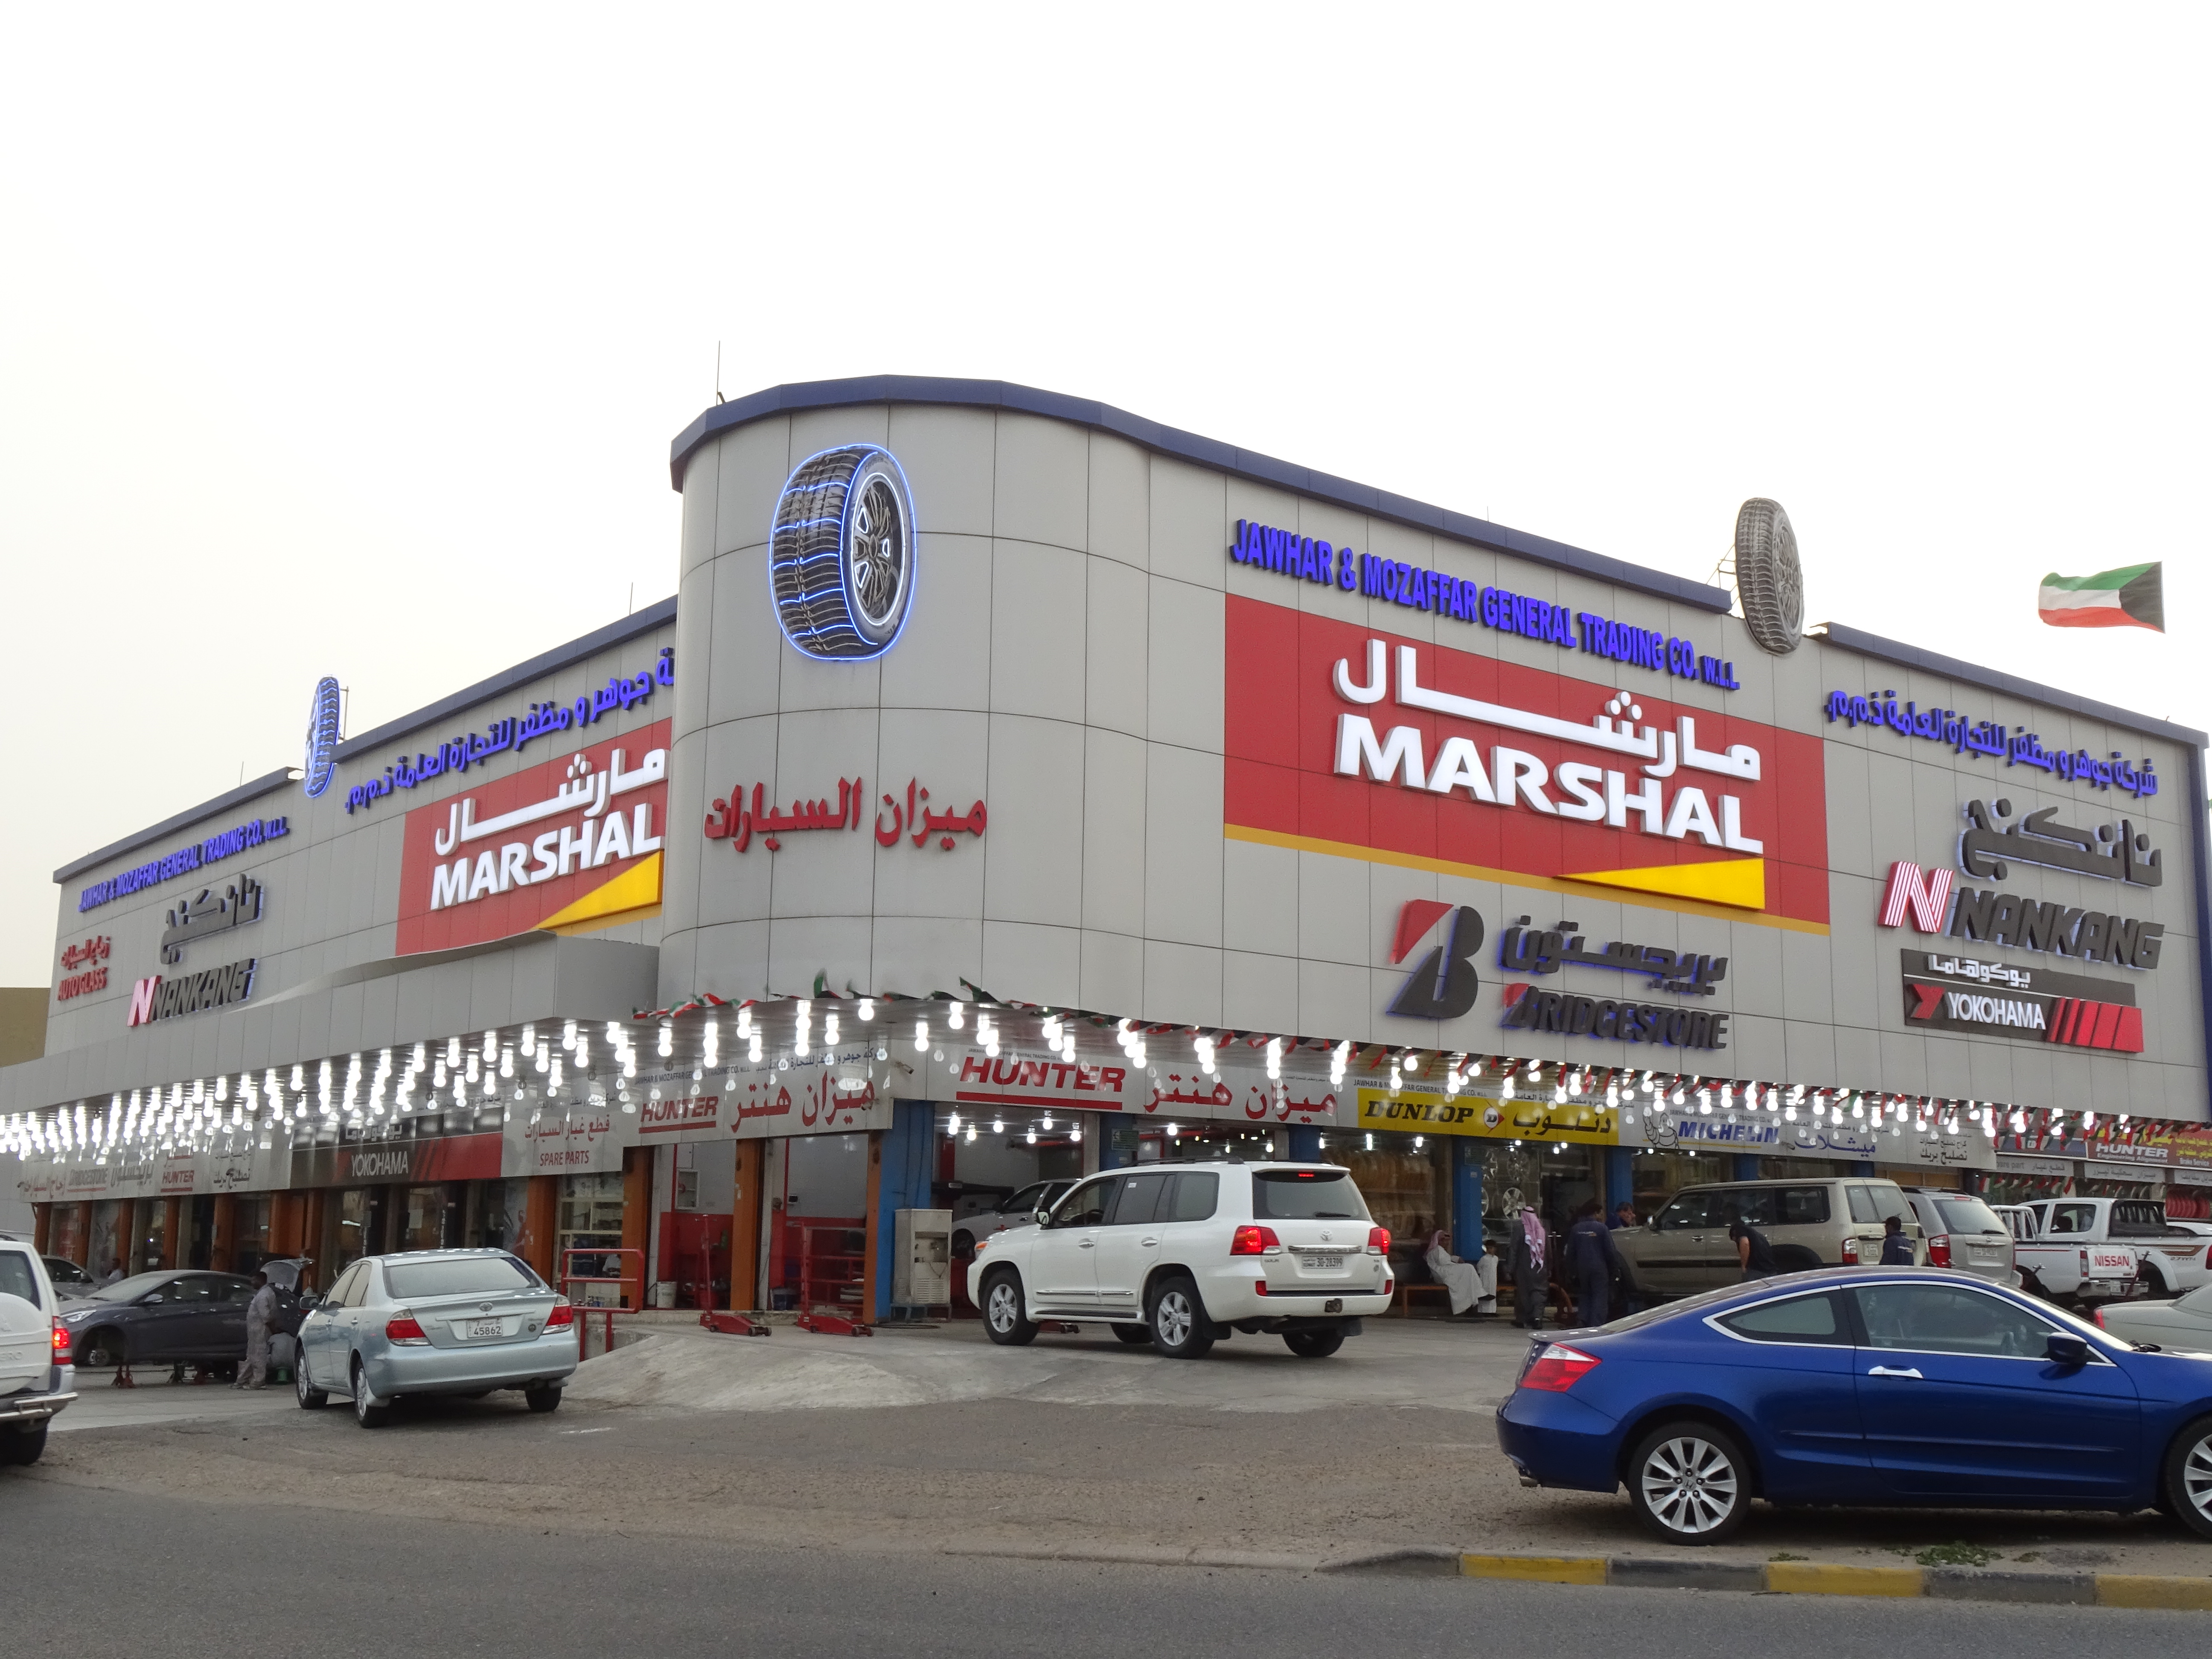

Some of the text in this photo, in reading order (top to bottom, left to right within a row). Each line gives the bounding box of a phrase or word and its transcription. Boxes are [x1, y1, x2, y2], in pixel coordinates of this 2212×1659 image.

[1230, 518, 1333, 585] JAWHAR
[1339, 547, 1356, 591] &
[1361, 553, 1478, 623] MOZAFFAR
[1480, 586, 1577, 648] GENERAL
[1578, 612, 1664, 671] TRADING
[1666, 637, 1699, 680] CO.
[574, 696, 589, 727] و
[590, 672, 654, 723] جوهر
[1332, 638, 1761, 781] مارشال
[1884, 690, 1944, 741] العامة
[449, 717, 516, 772] للتجارة
[514, 701, 572, 751] مظفر
[1944, 710, 2007, 758] للتجارة
[393, 743, 451, 788] العامة
[2007, 726, 2055, 772] مظفر
[2057, 750, 2069, 779] و
[1334, 713, 1764, 854] MARSHAL
[2069, 750, 2112, 790] جوهر
[2111, 751, 2158, 798] شركة
[435, 749, 670, 855] مارشال
[704, 776, 987, 853] ميزان السيارات
[79, 880, 109, 912] JAWHAR
[109, 878, 116, 899] &
[116, 861, 160, 899] MOZAFFAR
[160, 844, 202, 882] GENERAL
[202, 826, 247, 864] TRADING
[245, 818, 265, 848] CO.
[431, 803, 664, 910] MARSHAL
[1950, 887, 2165, 969] NANKANG
[1500, 915, 1729, 995] بريجستون
[1928, 955, 2031, 989] يوكوهاما
[150, 959, 255, 1021] NANKANG
[1501, 983, 1729, 1049] BRIDGESTONE
[1948, 992, 2046, 1030] YOKOHAMA
[659, 1072, 684, 1082] MOZAFFAR
[842, 1053, 861, 1064] جوهر
[960, 1057, 1126, 1092] HUNTER
[731, 1070, 875, 1134] ميزان هنتر
[1143, 1074, 1337, 1123] ميزان هنتر
[1353, 1079, 1377, 1087] JAWHAR
[1415, 1086, 1441, 1094] GENERAL
[1515, 1092, 1537, 1101] العامة
[525, 1114, 610, 1143] قطع غيار السيارات
[641, 1096, 719, 1123] HUNTER
[1365, 1100, 1474, 1124] DUNLOP
[1513, 1111, 1611, 1136] دنلوب
[1678, 1121, 1778, 1143] MICHELIN
[1794, 1134, 1875, 1157] ميشلان
[2096, 1143, 2169, 1158] HUNTER
[162, 1170, 195, 1184] HUNTER
[351, 1151, 408, 1177] YOKOHAMA
[540, 1150, 589, 1167] SPARE PARTS
[2094, 1255, 2130, 1266] NISSAN
[474, 1326, 501, 1336] 45862
